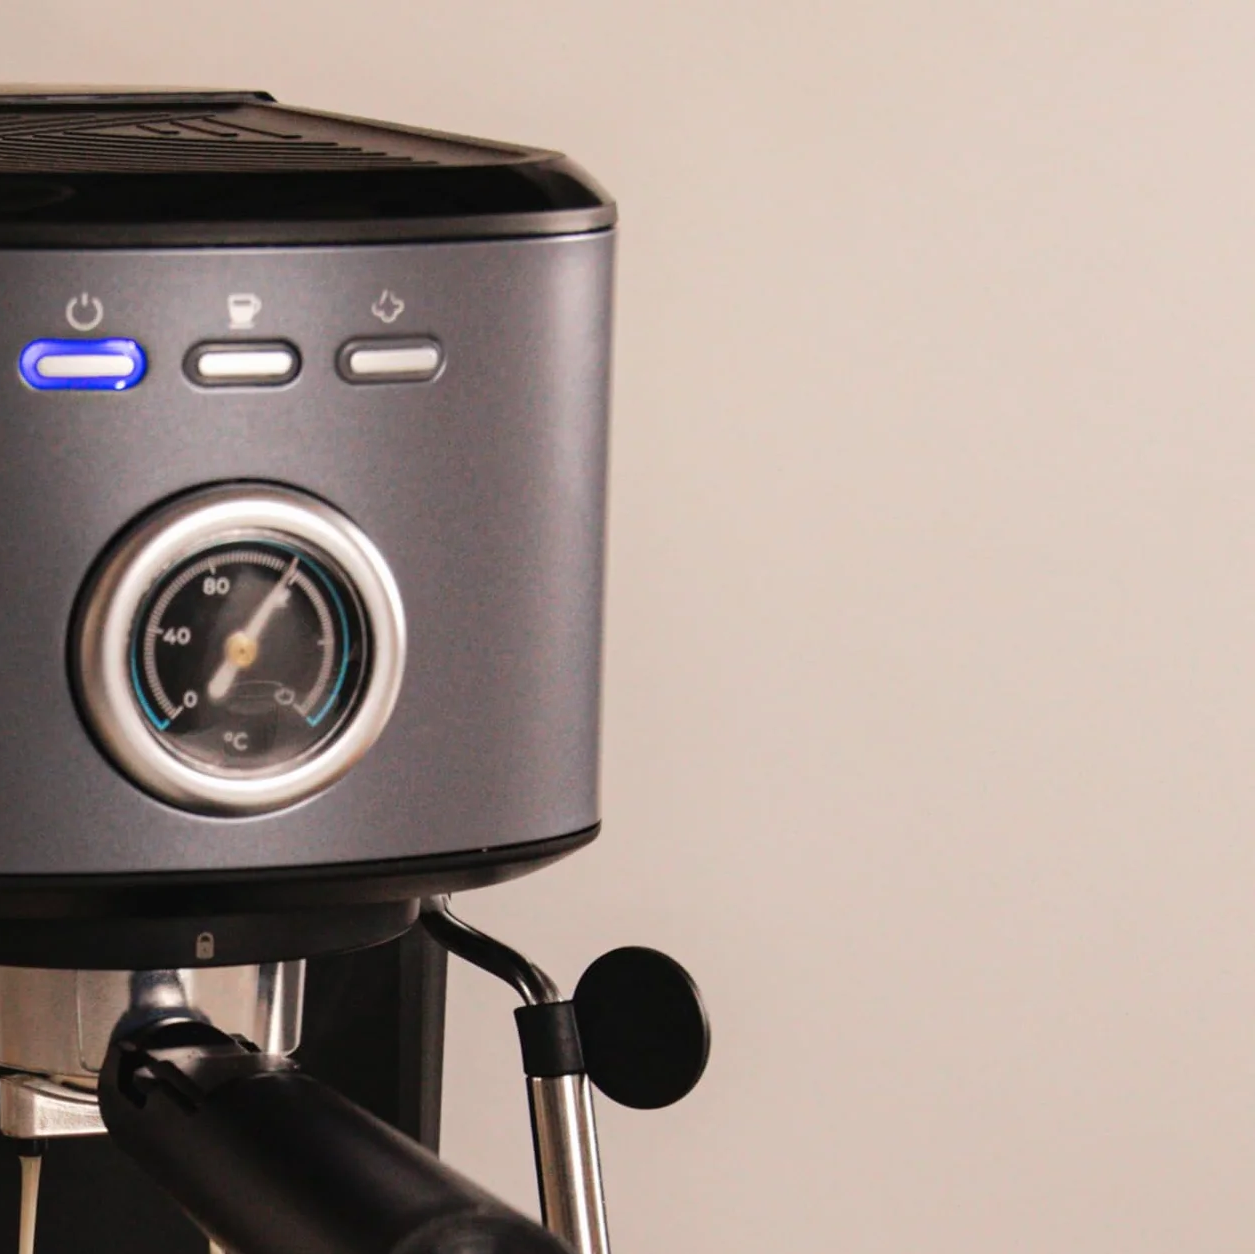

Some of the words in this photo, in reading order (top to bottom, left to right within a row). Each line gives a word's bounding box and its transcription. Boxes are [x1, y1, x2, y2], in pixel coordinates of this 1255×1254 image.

[202, 577, 230, 595] 80
[163, 627, 191, 645] 40
[184, 689, 198, 708] 0
